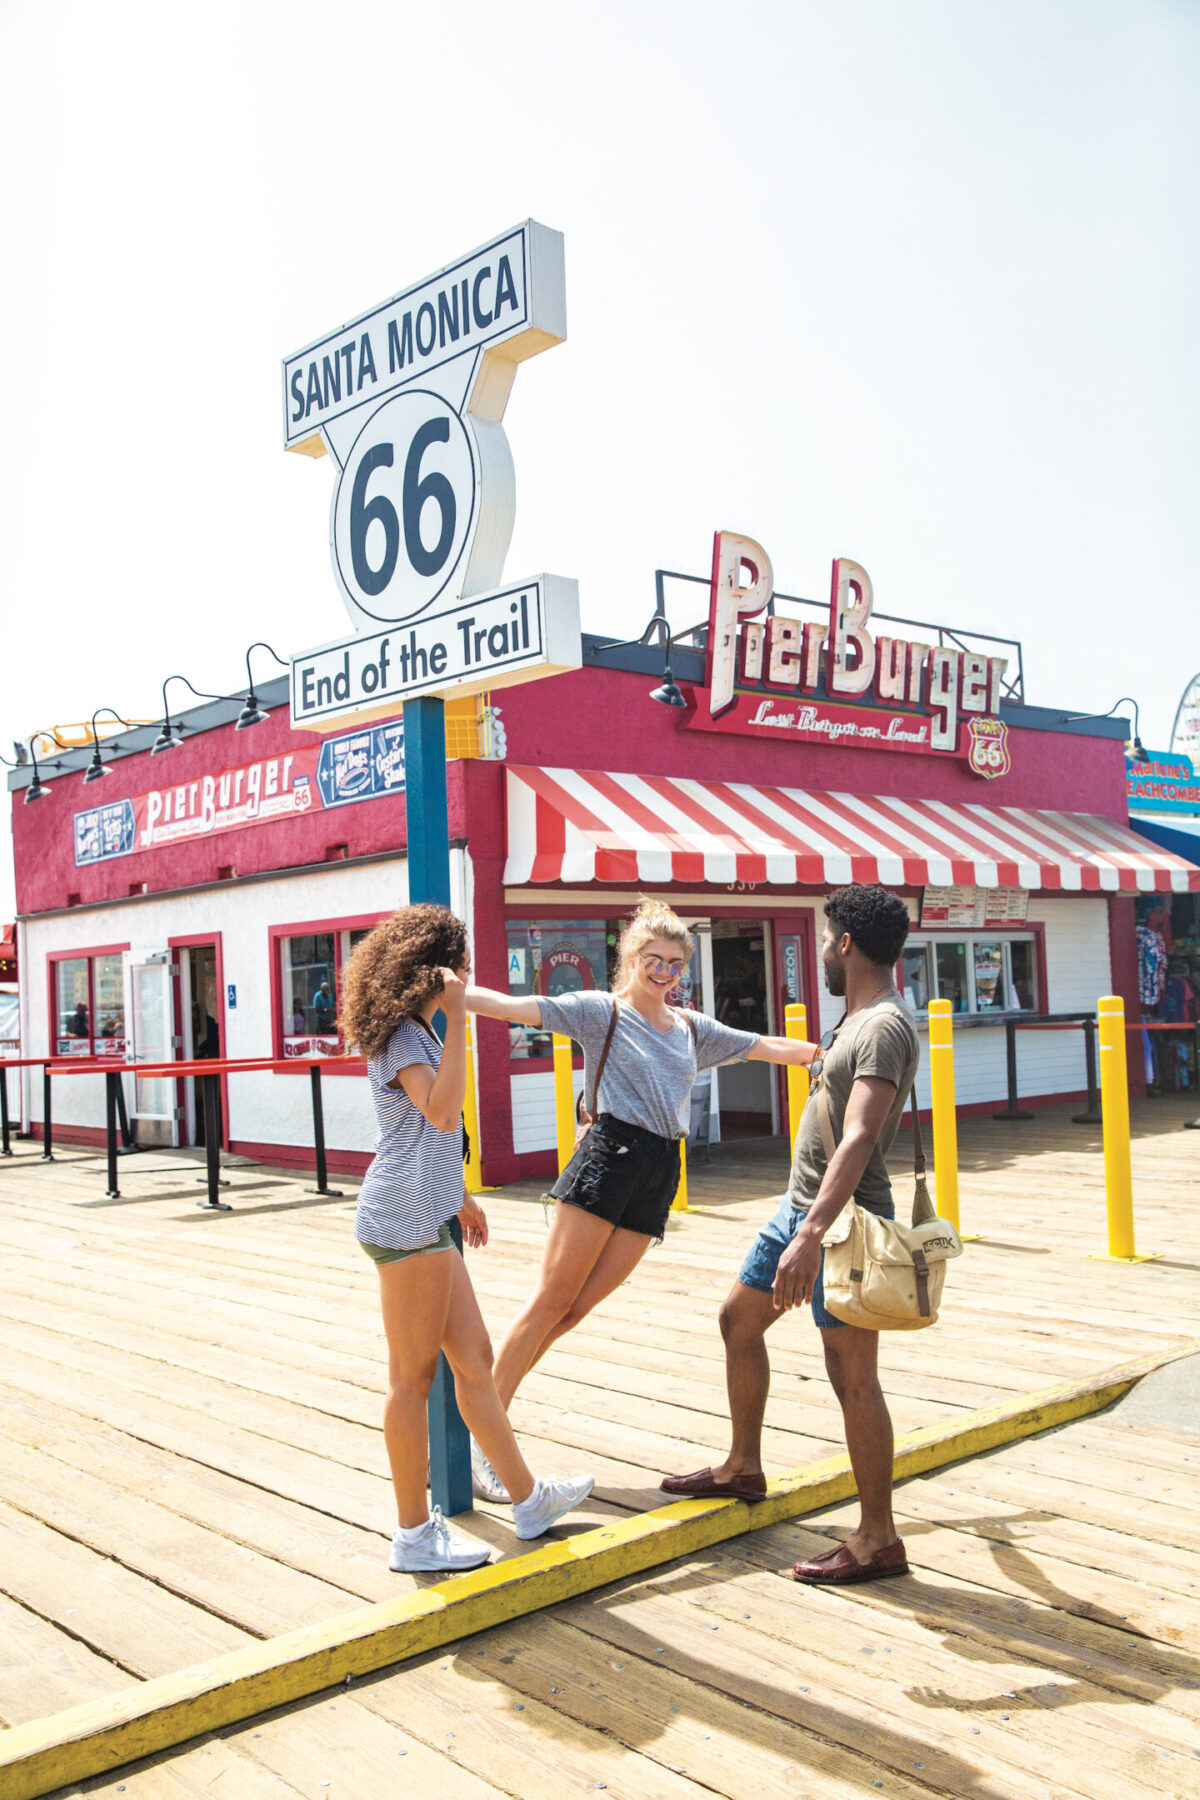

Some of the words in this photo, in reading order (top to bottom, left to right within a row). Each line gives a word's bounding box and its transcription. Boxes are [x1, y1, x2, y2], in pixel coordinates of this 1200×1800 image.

[290, 332, 378, 423] SANTA
[388, 255, 519, 375] MONICA
[350, 417, 456, 597] 66
[302, 653, 351, 711] End
[361, 639, 390, 693] of
[401, 631, 447, 687] the
[457, 596, 529, 665] Trail
[974, 740, 1002, 767] 66
[1130, 760, 1190, 780] Marlene's
[294, 787, 310, 807] 66
[509, 954, 521, 972] A
[549, 952, 580, 967] PIER
[785, 946, 796, 998] CONES
